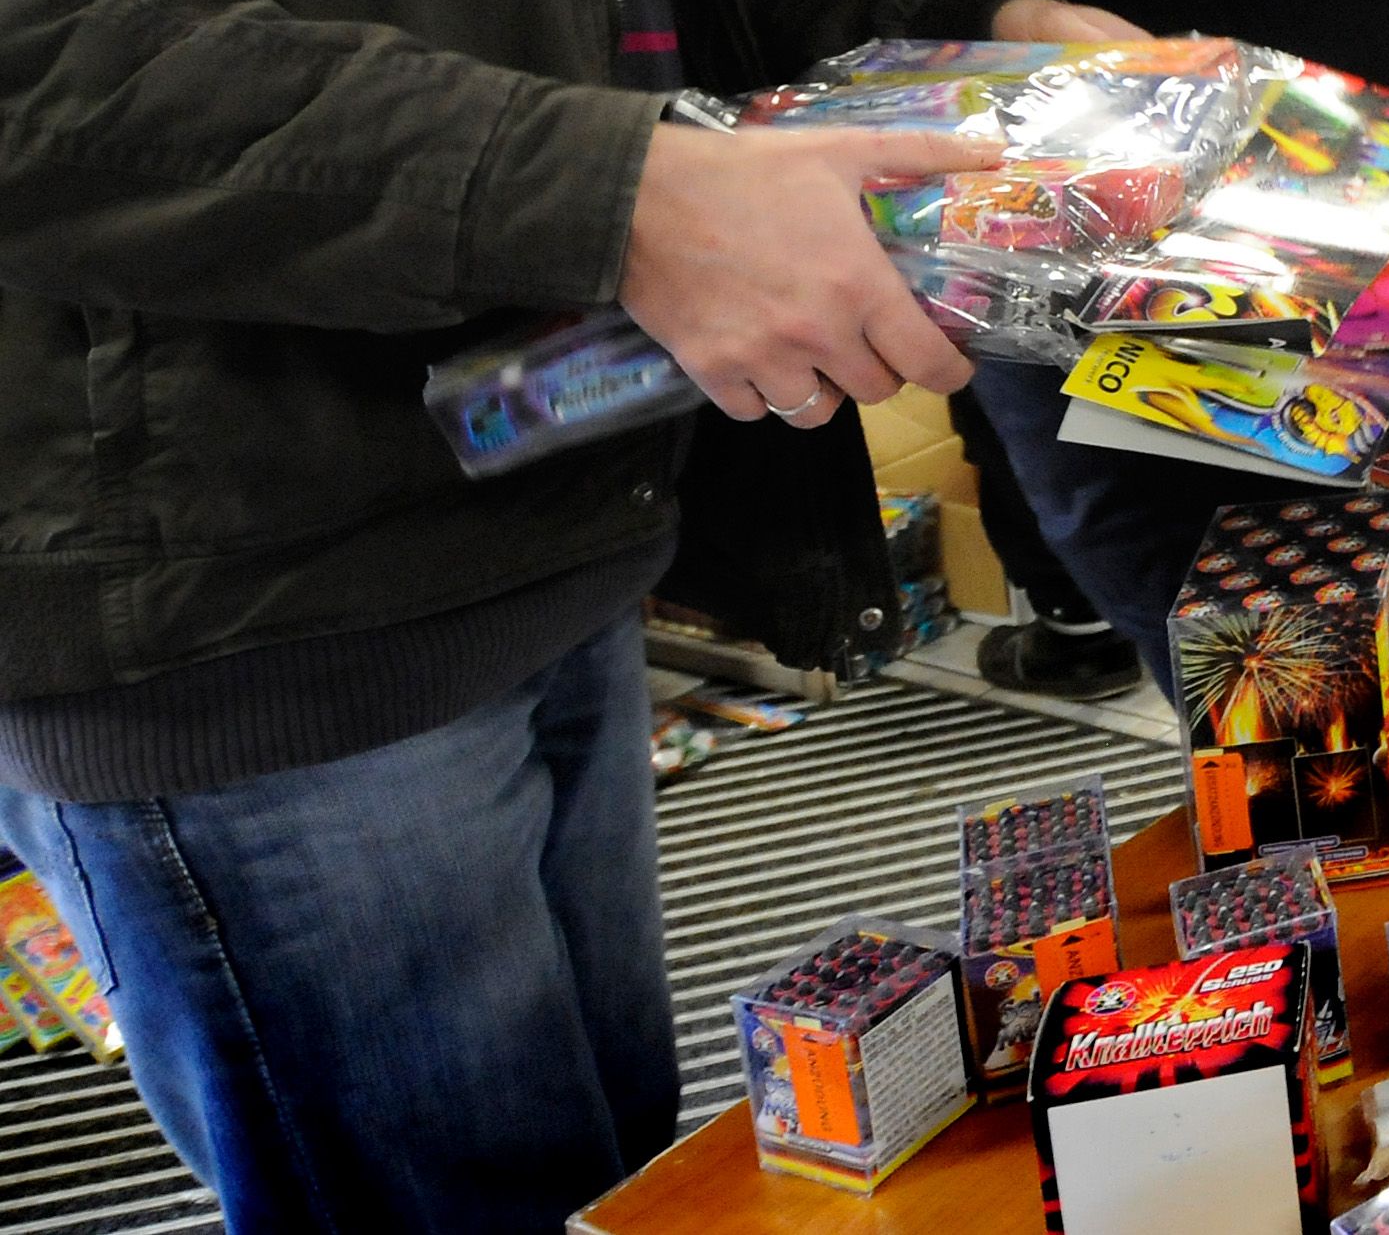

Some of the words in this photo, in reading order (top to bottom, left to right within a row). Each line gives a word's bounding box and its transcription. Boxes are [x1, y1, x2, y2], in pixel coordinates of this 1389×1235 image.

[1098, 340, 1145, 394] NICO
[1226, 958, 1284, 978] 250
[1065, 1000, 1275, 1072] Knallteppich
